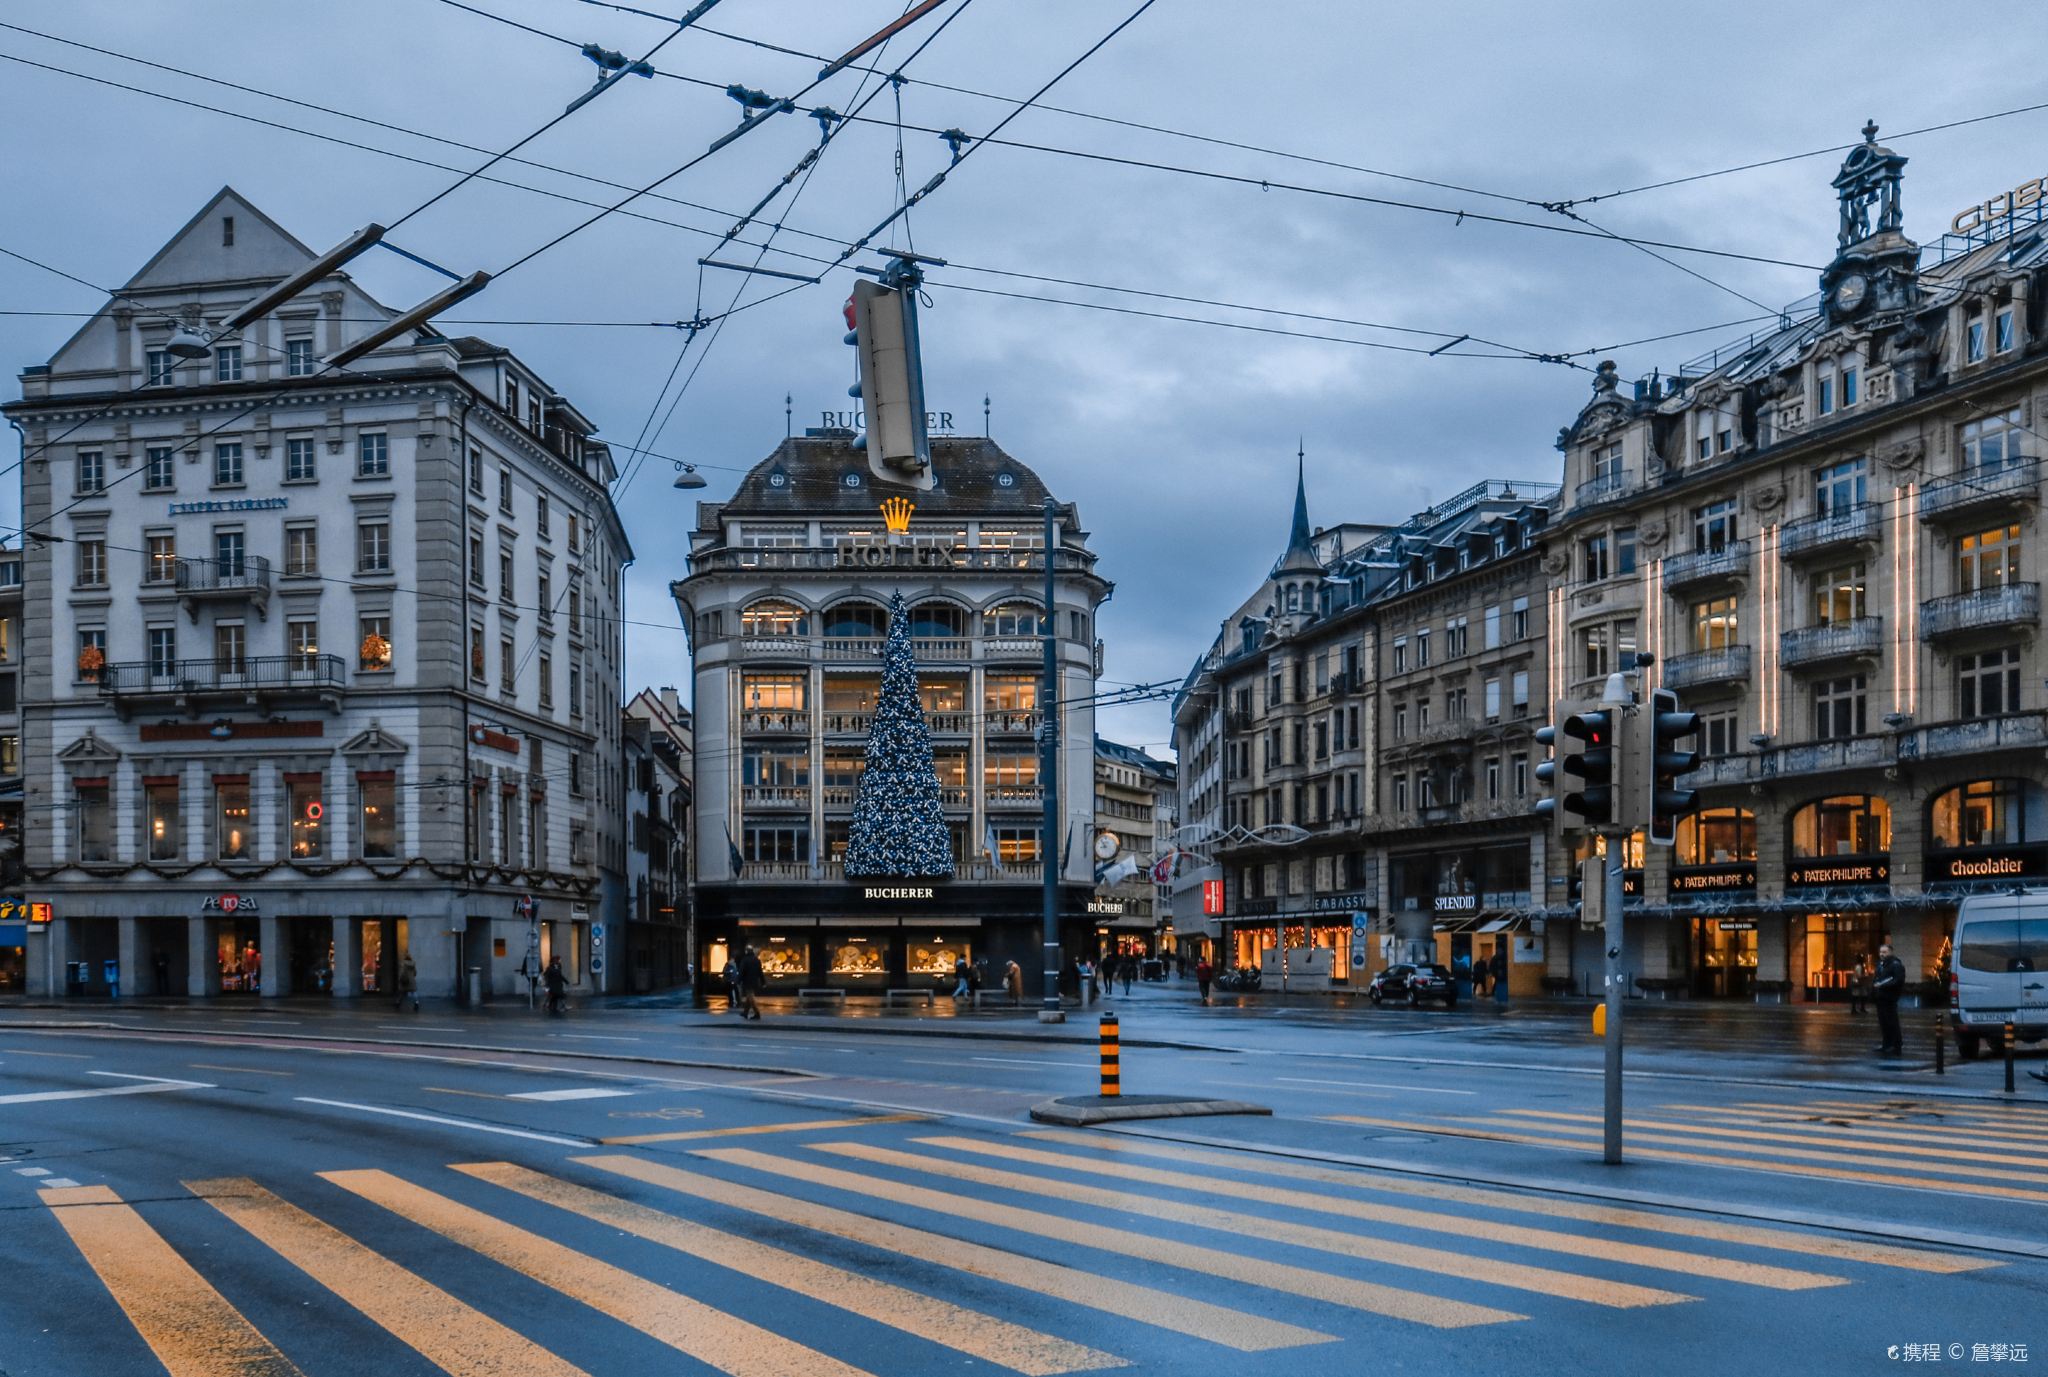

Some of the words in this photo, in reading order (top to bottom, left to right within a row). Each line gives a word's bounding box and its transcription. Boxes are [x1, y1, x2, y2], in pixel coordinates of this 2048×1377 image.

[1951, 176, 2048, 235] GÜB
[821, 411, 955, 429] BUCER
[837, 543, 958, 567] ROLEX
[1684, 876, 1707, 889] PATEK
[1708, 873, 1742, 887] PHILIPPE
[1804, 869, 1831, 882] PATEK
[1832, 867, 1872, 880] PHILIPPE
[864, 887, 934, 899] BUCHERER
[1315, 896, 1366, 910] EMBASSY
[1435, 895, 1476, 911] SPLENDID
